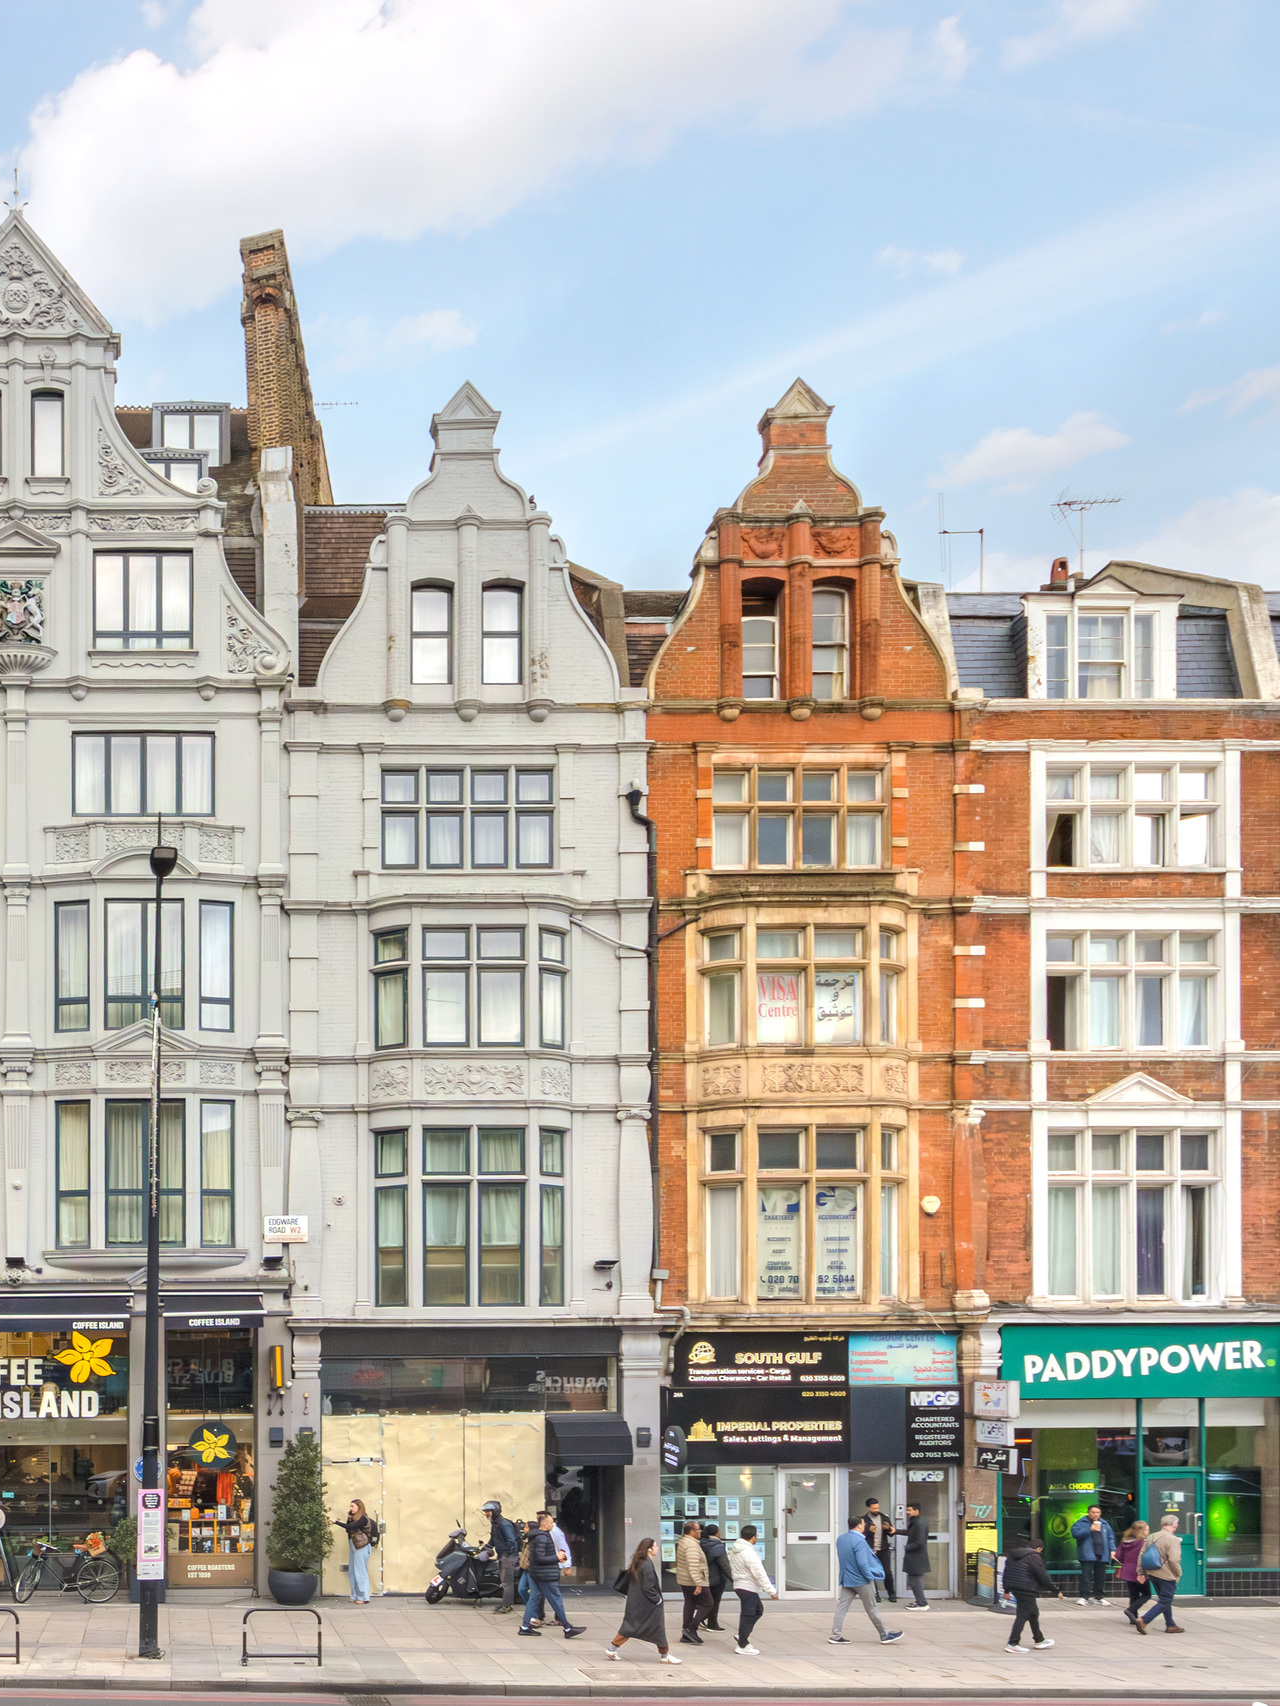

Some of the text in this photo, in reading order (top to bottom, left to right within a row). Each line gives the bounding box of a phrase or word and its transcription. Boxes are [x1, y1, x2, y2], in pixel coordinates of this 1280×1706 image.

[816, 975, 854, 990] ترجمة
[759, 976, 797, 1001] VISA
[758, 1003, 797, 1018] Centre
[268, 1218, 299, 1226] EDGWARE
[767, 1275, 785, 1284] 020
[788, 1275, 799, 1284] 70
[832, 1274, 855, 1283] 5044
[72, 1321, 124, 1329] COFFEE ISLAND
[189, 1318, 240, 1326] COFFEE ISLAND
[735, 1352, 822, 1365] SOUTH GULF
[688, 1368, 736, 1376] Transportation
[769, 1368, 790, 1376] Cargo
[910, 1391, 959, 1406] MPGG
[716, 1421, 842, 1431] IMPERIAL PROPERTIES
[723, 1434, 842, 1443] Sales, Lettings & Management
[980, 1450, 1007, 1463] مترجم
[1068, 1482, 1095, 1490] CHOICE
